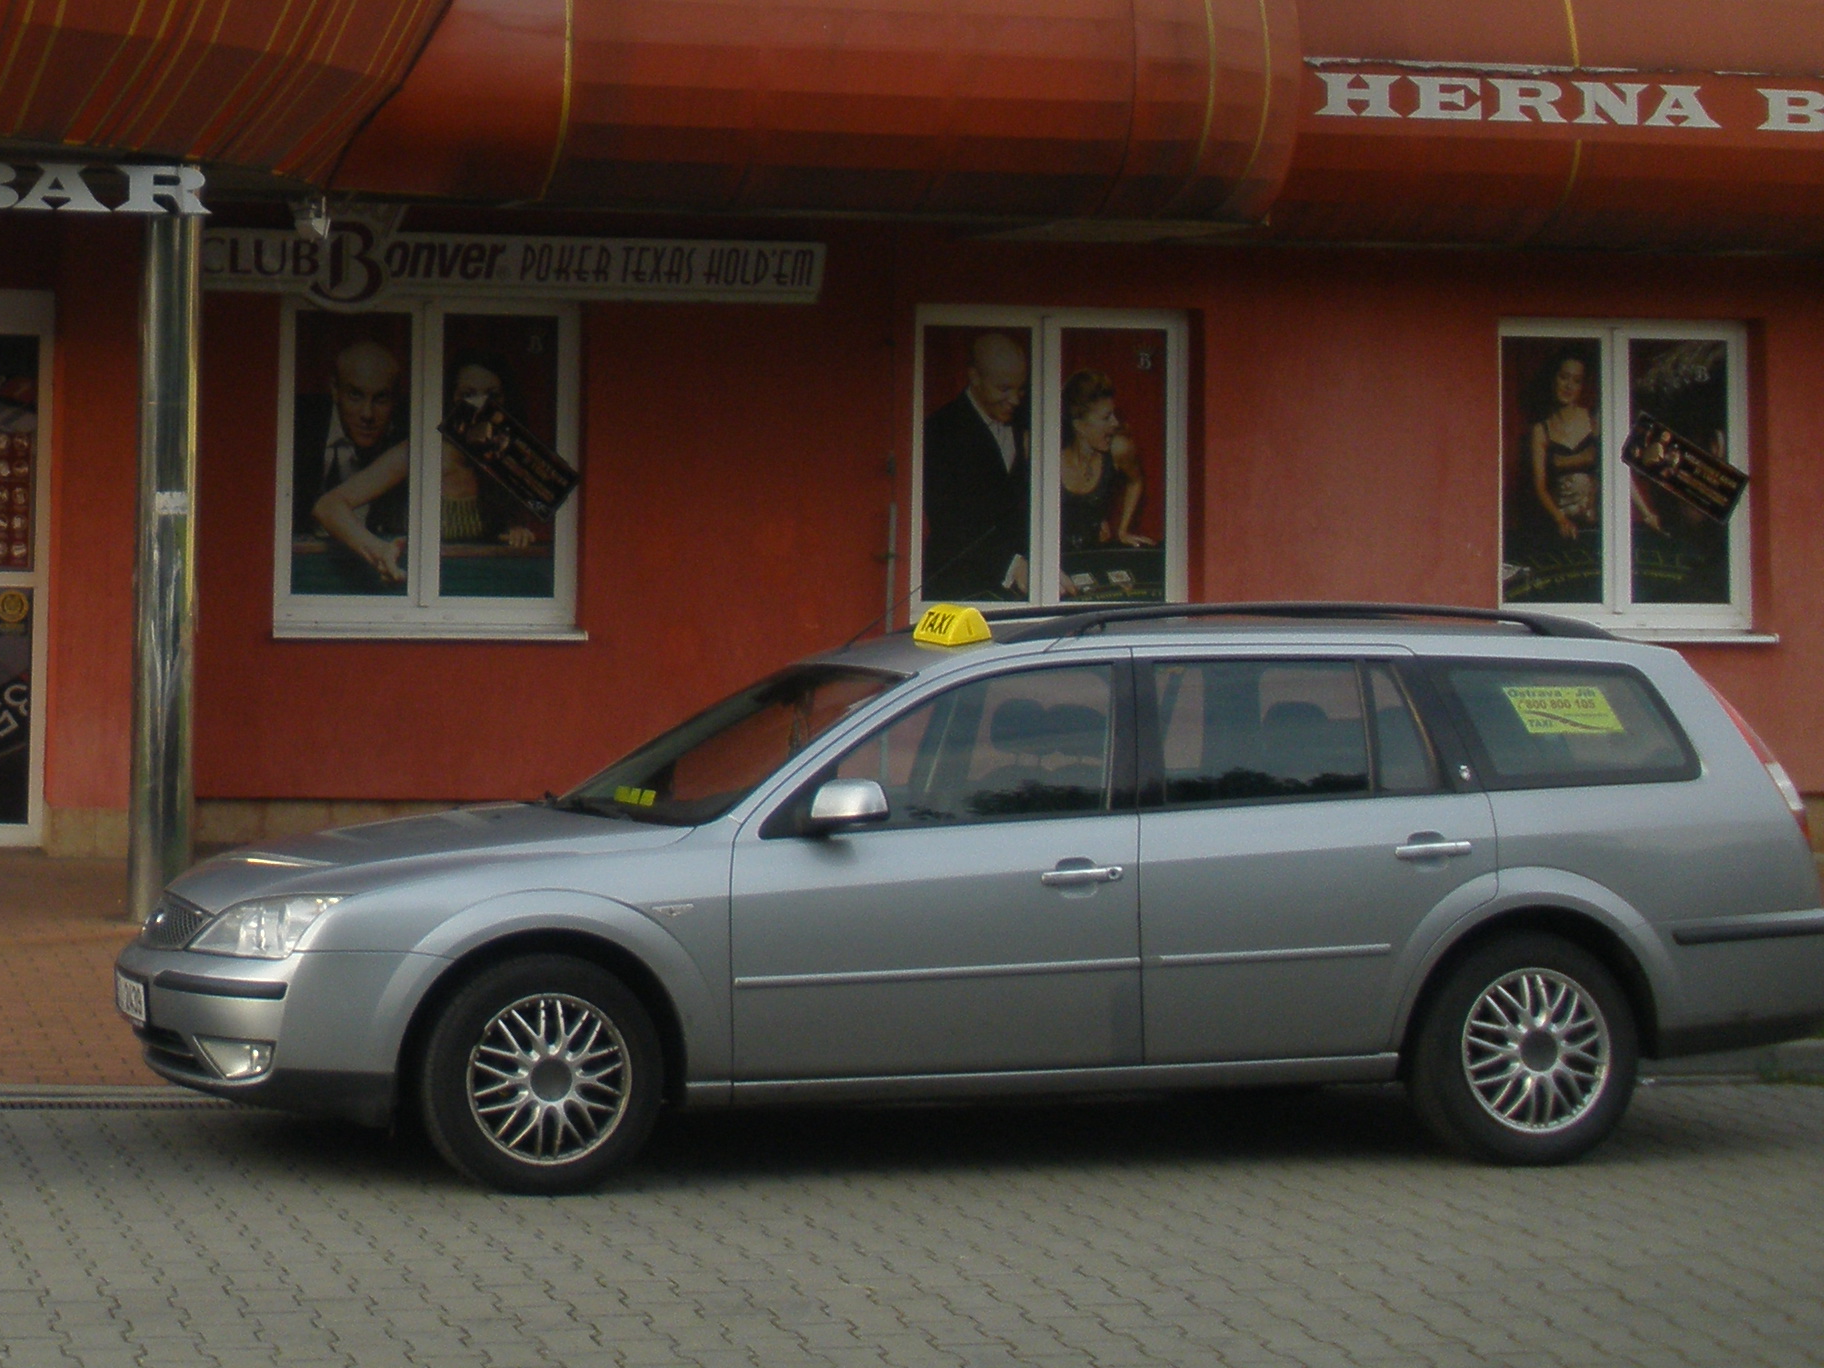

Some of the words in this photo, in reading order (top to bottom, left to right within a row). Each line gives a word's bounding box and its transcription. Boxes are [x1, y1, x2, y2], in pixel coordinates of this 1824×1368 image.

[1314, 71, 1723, 128] HERNA
[202, 236, 320, 277] CLUB
[520, 243, 612, 282] POKER
[622, 245, 697, 283] TEXAS
[920, 611, 956, 635] TAXI
